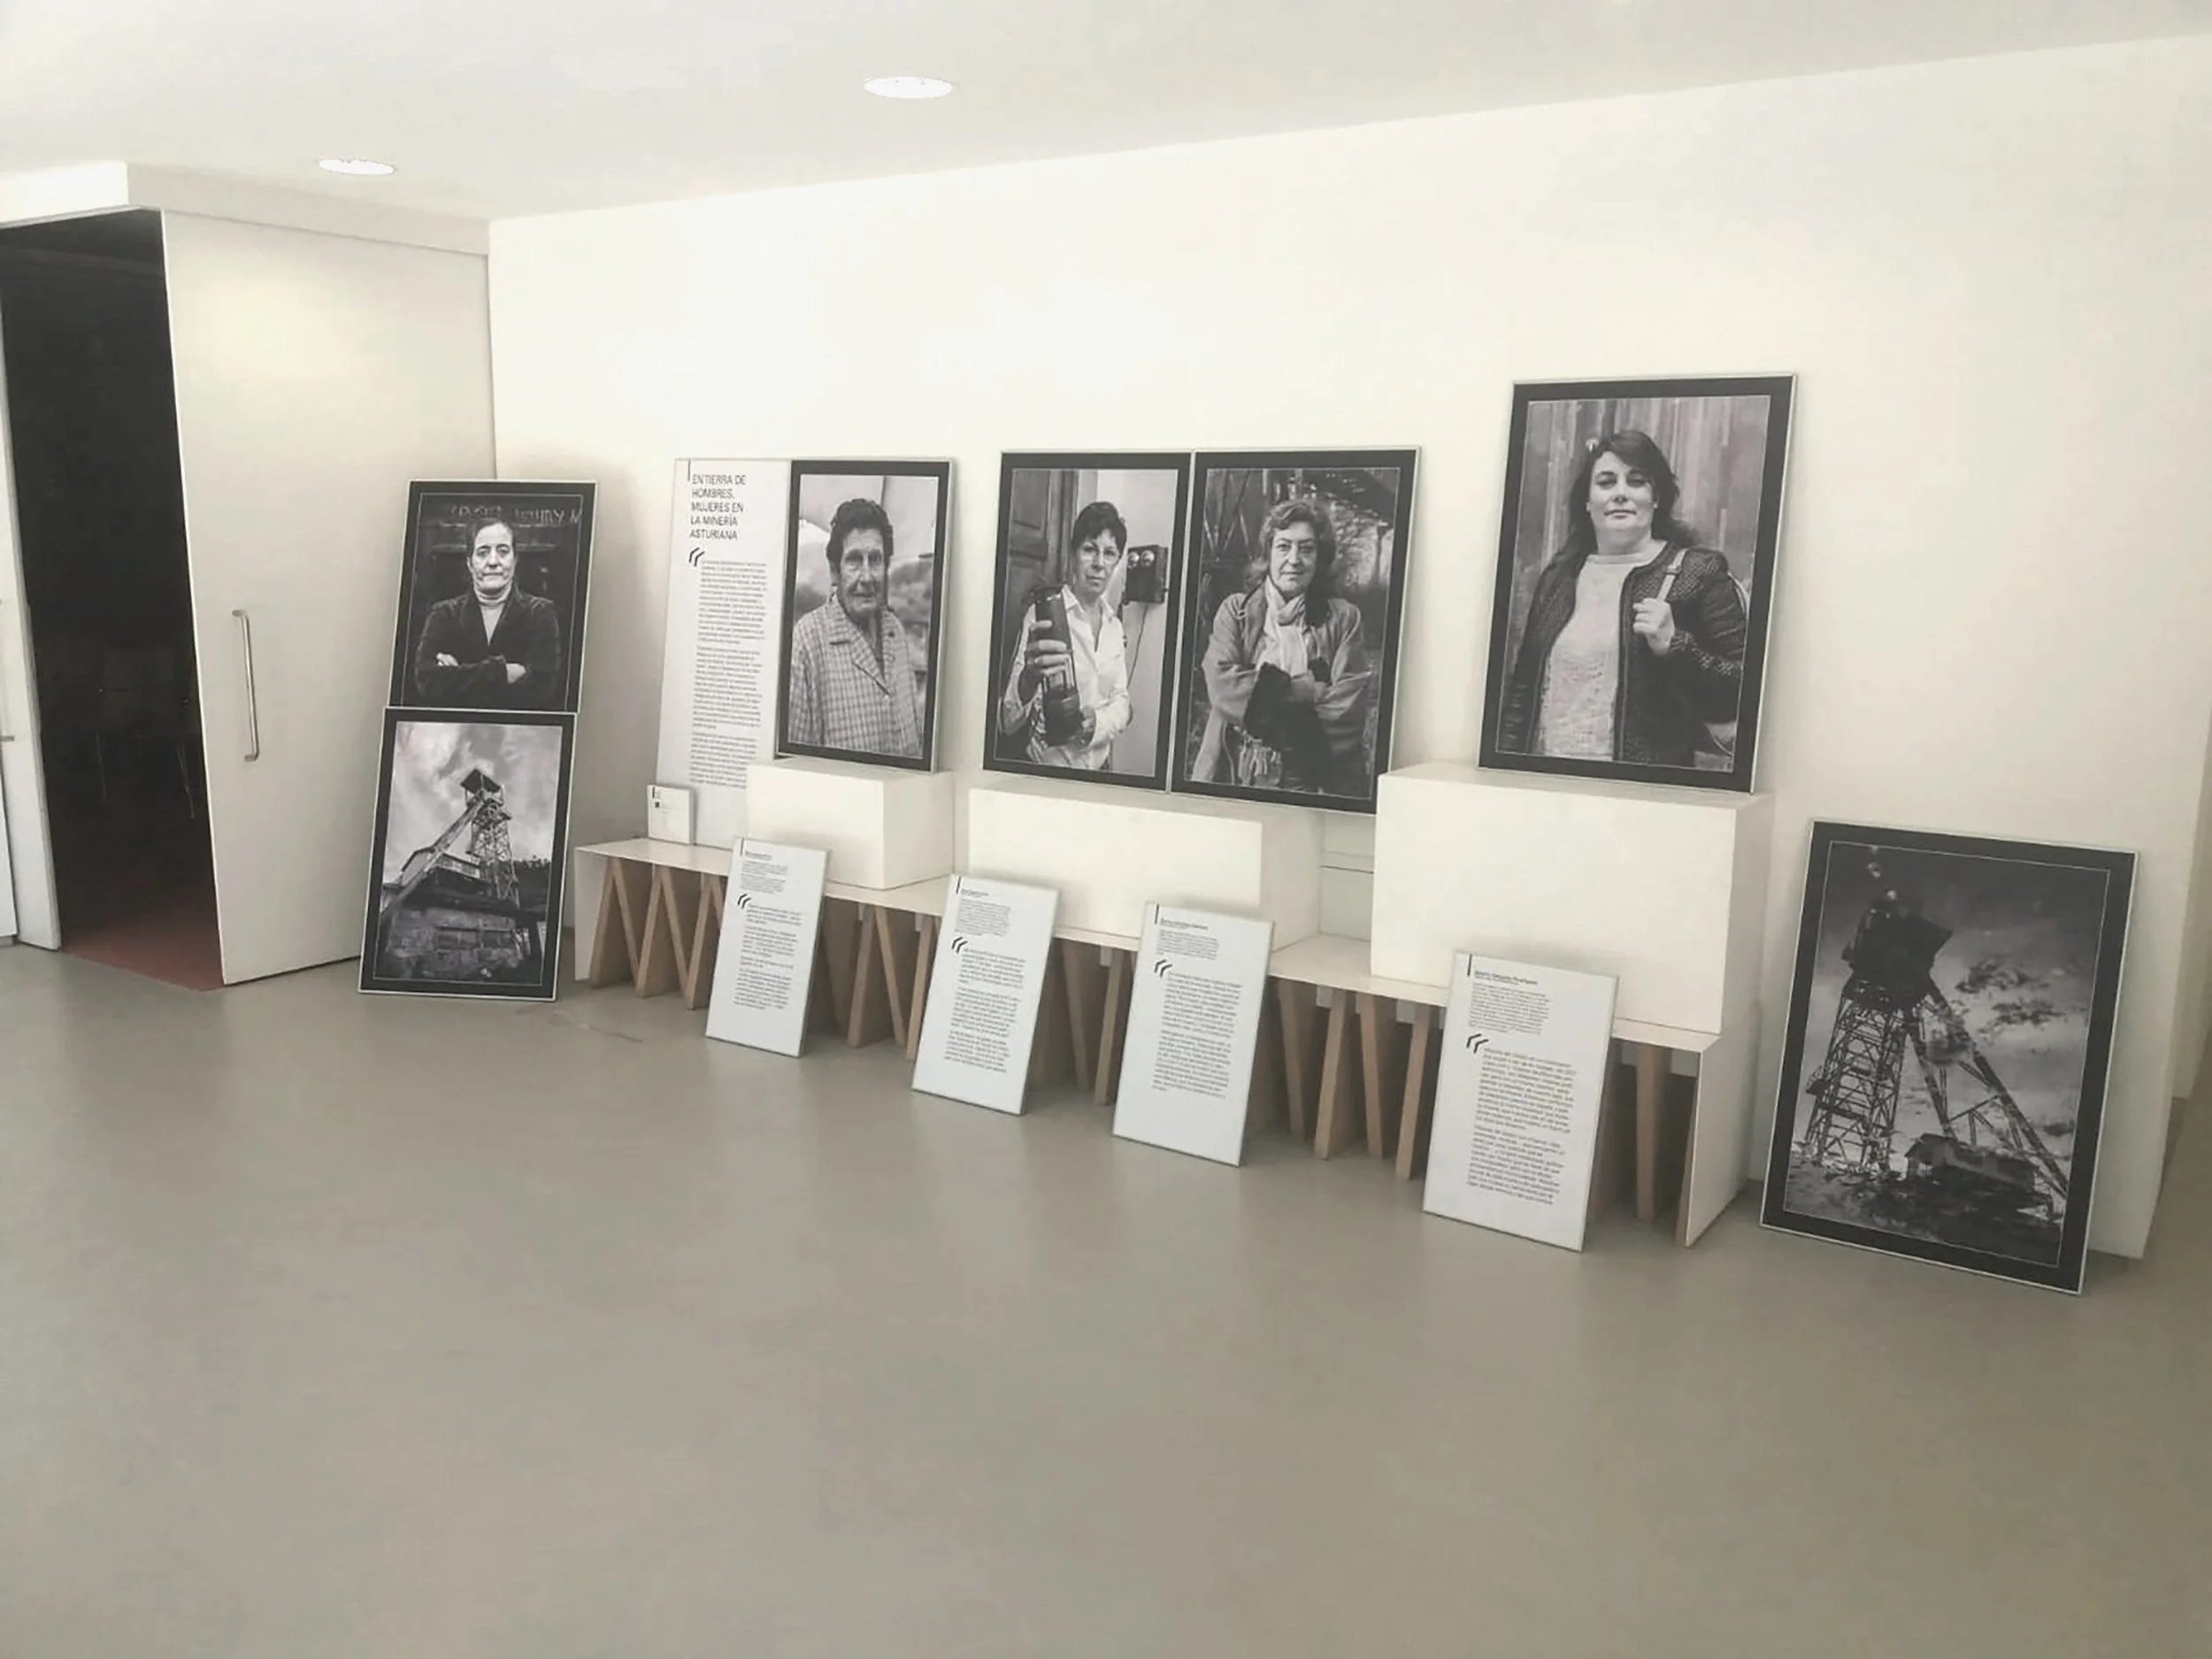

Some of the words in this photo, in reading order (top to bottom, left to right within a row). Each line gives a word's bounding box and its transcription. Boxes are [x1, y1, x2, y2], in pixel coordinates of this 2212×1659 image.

[704, 474, 733, 485] TIERRA
[734, 474, 746, 486] DE
[691, 502, 730, 512] MUJERES
[732, 502, 743, 513] EN
[690, 515, 701, 525] LA
[689, 528, 738, 540] ASTURIANA
